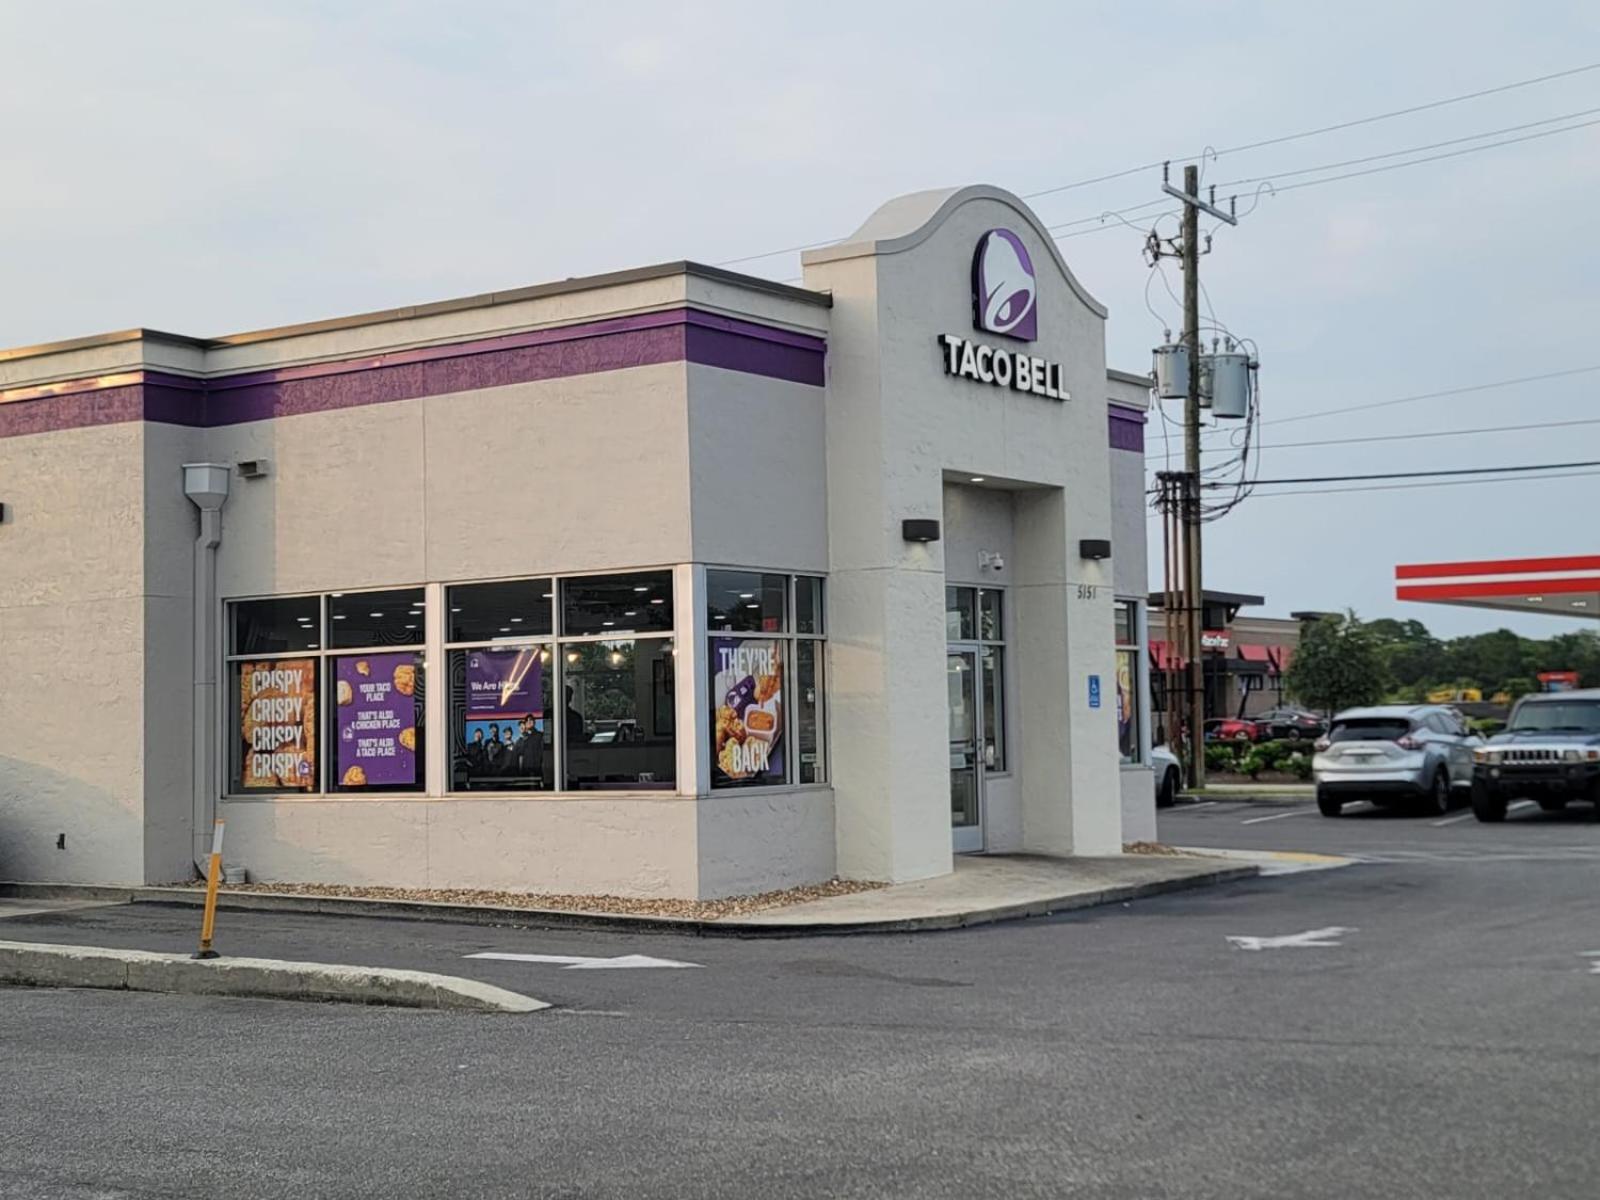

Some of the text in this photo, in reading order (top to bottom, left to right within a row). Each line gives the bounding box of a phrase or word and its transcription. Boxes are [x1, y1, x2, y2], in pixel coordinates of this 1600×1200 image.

[943, 334, 1071, 401] TACO BELL
[1077, 583, 1096, 600] 5151
[718, 647, 775, 676] THEY'RE
[252, 669, 302, 696] CRISPY
[359, 682, 391, 693] YOUR TACO
[471, 681, 482, 691] We
[483, 681, 497, 690] Are
[366, 692, 385, 702] PLACE
[252, 697, 302, 722] CRISPY
[378, 710, 394, 720] ALSO
[356, 720, 381, 730] CHICKEN
[382, 719, 401, 729] PLACE
[253, 725, 302, 751] CRISPY
[378, 738, 394, 748] ALSO
[356, 746, 396, 757] A TACO PLACE
[732, 741, 770, 773] BACK
[253, 752, 302, 778] CRISPY
